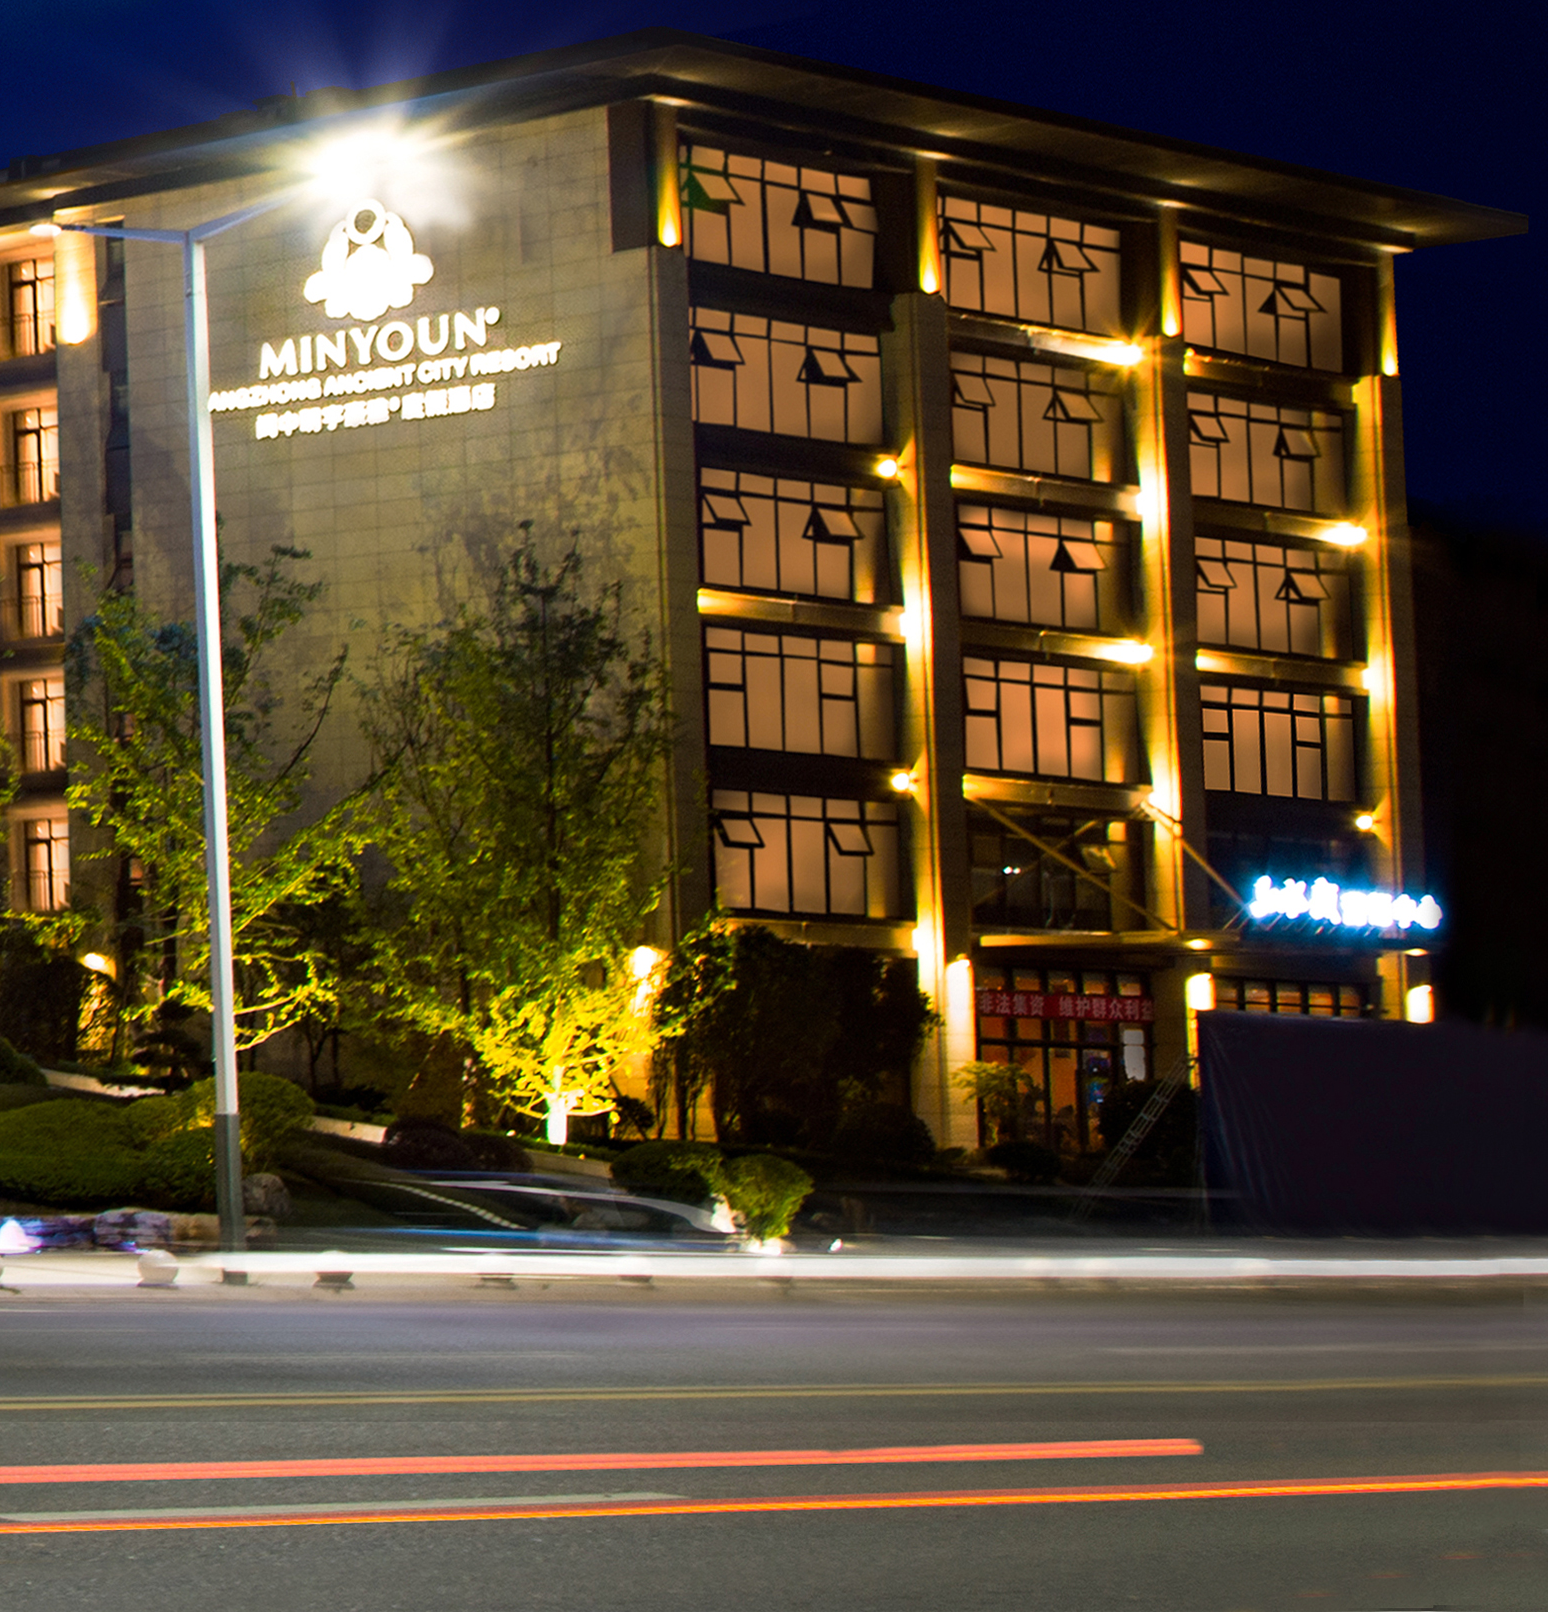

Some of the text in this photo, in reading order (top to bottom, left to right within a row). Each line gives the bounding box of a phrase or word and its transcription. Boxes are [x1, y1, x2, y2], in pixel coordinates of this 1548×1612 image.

[208, 377, 322, 413] ANGZHONG
[323, 363, 417, 397] ANCIENT
[417, 355, 469, 384] CITY
[469, 341, 562, 377] RESORT
[979, 992, 1045, 1017] 非法集资
